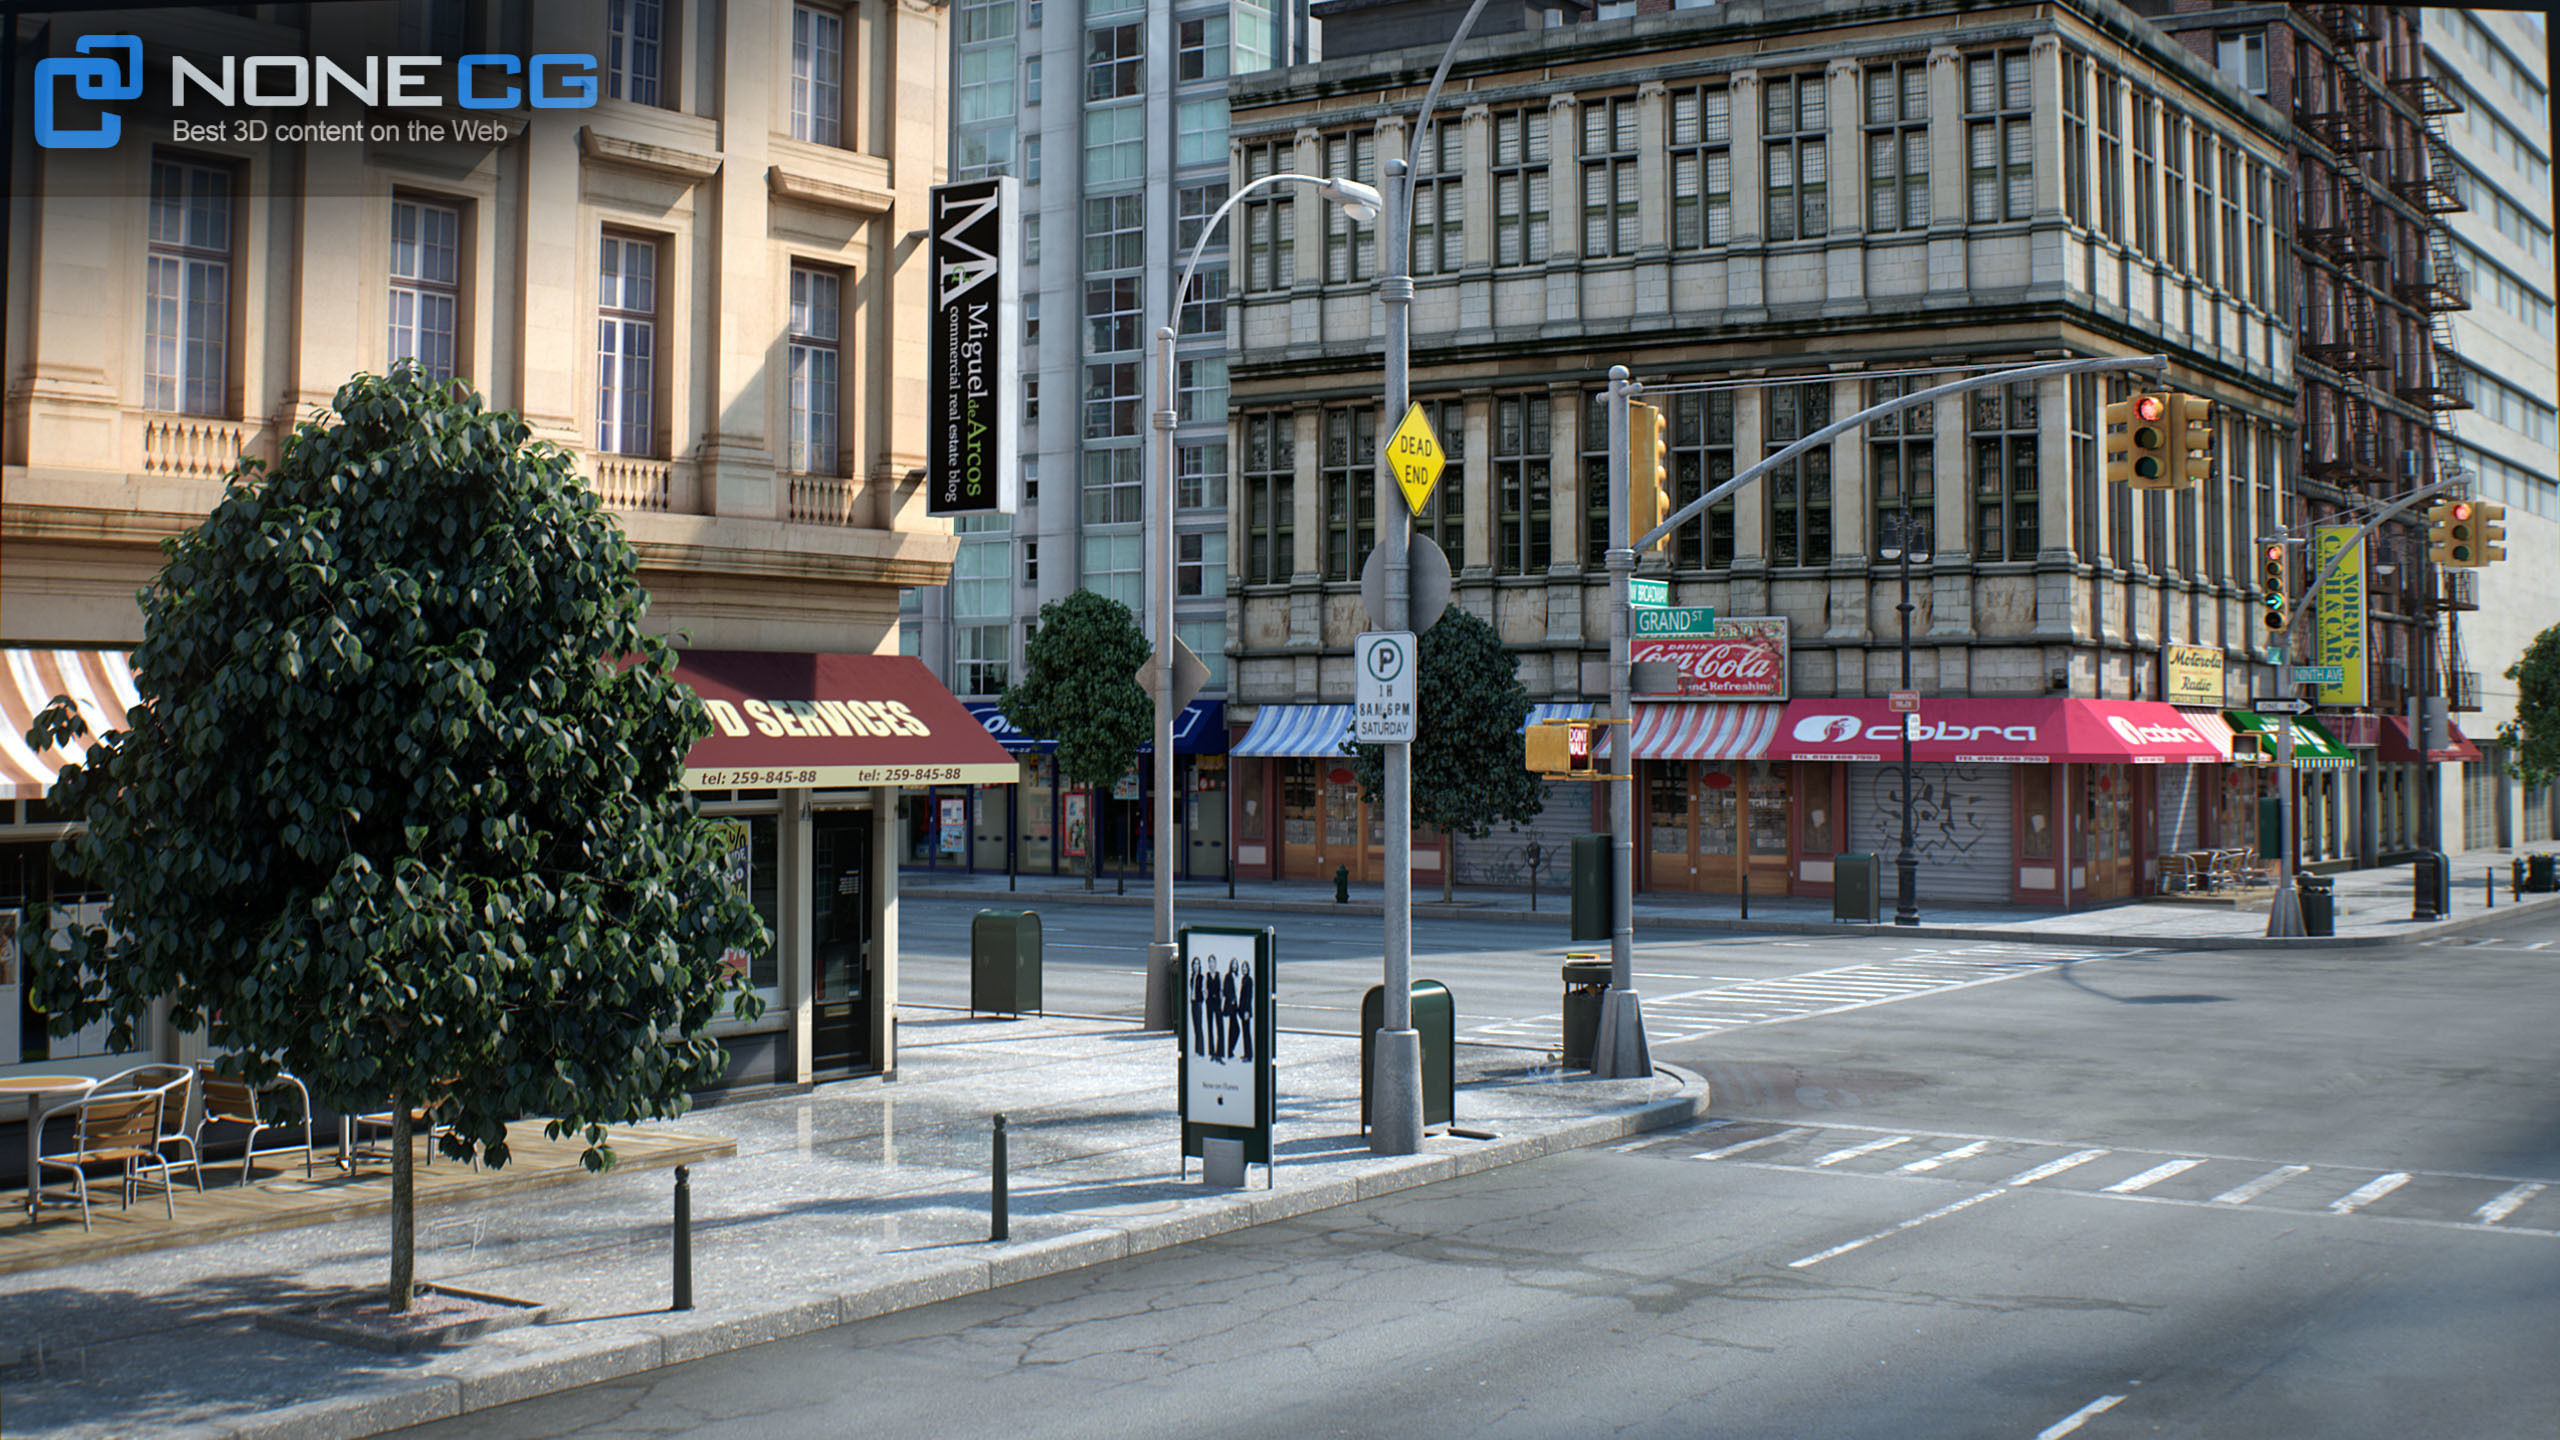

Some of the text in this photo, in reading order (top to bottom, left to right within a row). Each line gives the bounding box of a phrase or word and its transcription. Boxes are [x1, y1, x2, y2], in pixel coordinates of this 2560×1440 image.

[945, 306, 961, 503] commercial real estate blog
[1400, 435, 1432, 457] DEAD
[1405, 465, 1428, 485] END
[1639, 610, 1704, 631] GRAND ST
[1379, 647, 1395, 673] P
[2170, 649, 2222, 669] Motorola
[2326, 616, 2343, 695] CARY
[2181, 676, 2212, 692] Radio
[2295, 667, 2344, 681] NINTH AVE
[743, 698, 931, 737] SERVICES
[1361, 721, 1409, 736] SATURDAY
[2139, 723, 2204, 743] cobra
[1569, 742, 1588, 755] WALK
[701, 770, 817, 785] tel: 259-845-88
[858, 768, 961, 782] tel: 259-845-88
